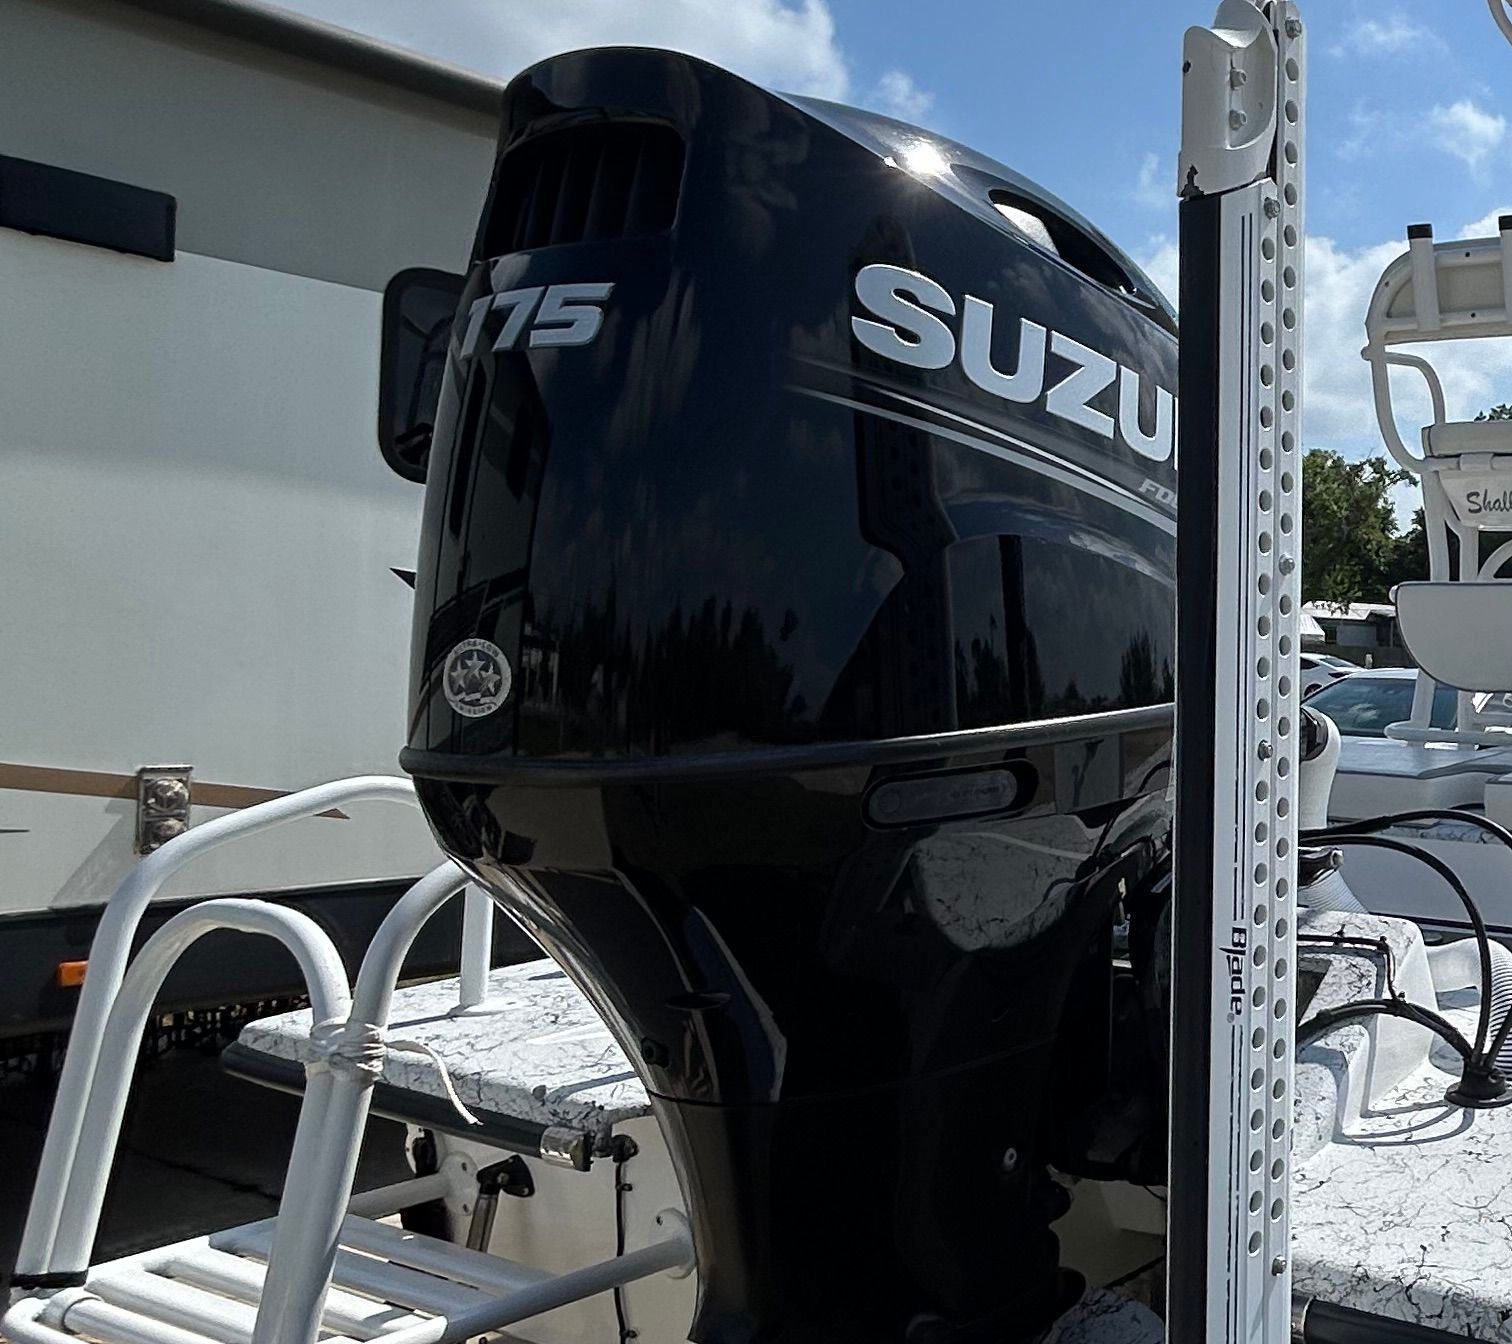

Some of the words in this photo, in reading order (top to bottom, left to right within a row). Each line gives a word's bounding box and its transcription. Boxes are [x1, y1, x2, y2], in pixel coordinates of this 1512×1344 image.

[461, 282, 616, 360] 175
[851, 263, 1178, 471] SUZU
[1218, 926, 1248, 1016] Blade
